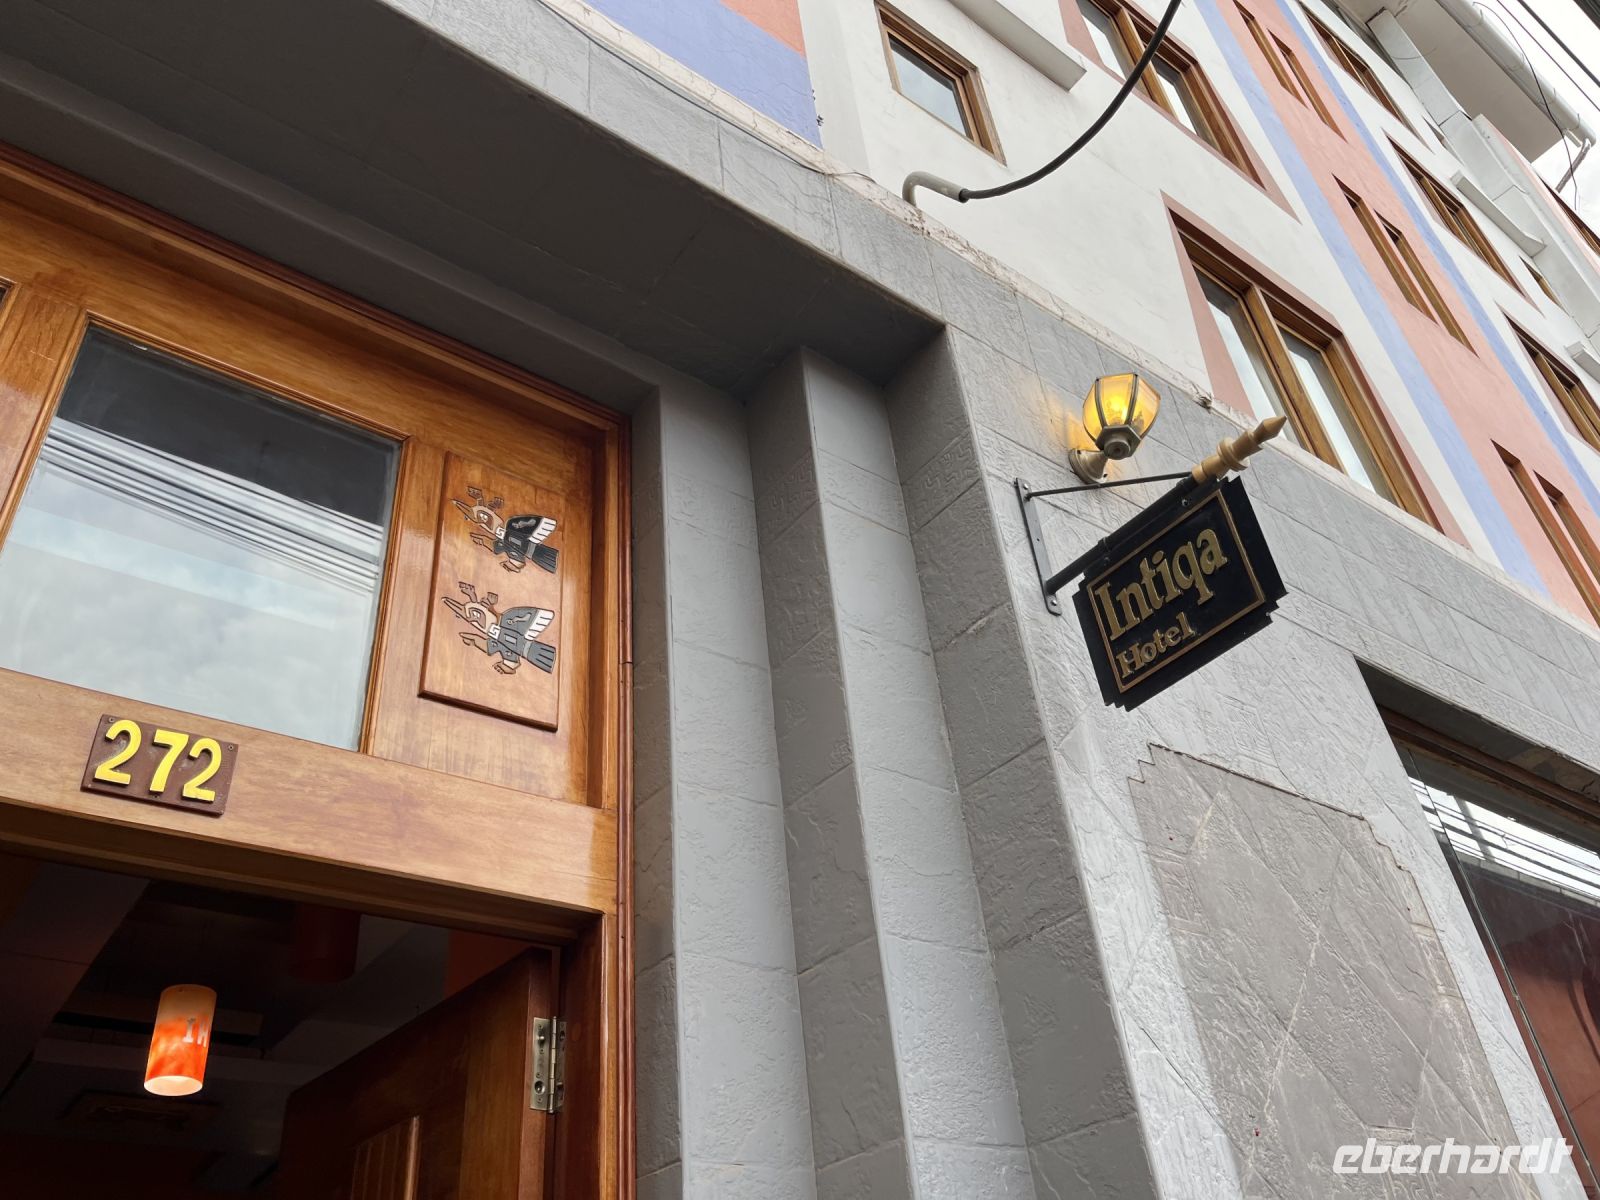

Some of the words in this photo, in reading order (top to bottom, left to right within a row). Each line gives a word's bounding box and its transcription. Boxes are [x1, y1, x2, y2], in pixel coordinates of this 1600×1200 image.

[1095, 528, 1228, 640] Intiqa
[1116, 612, 1195, 678] Hotel
[94, 719, 222, 802] 272
